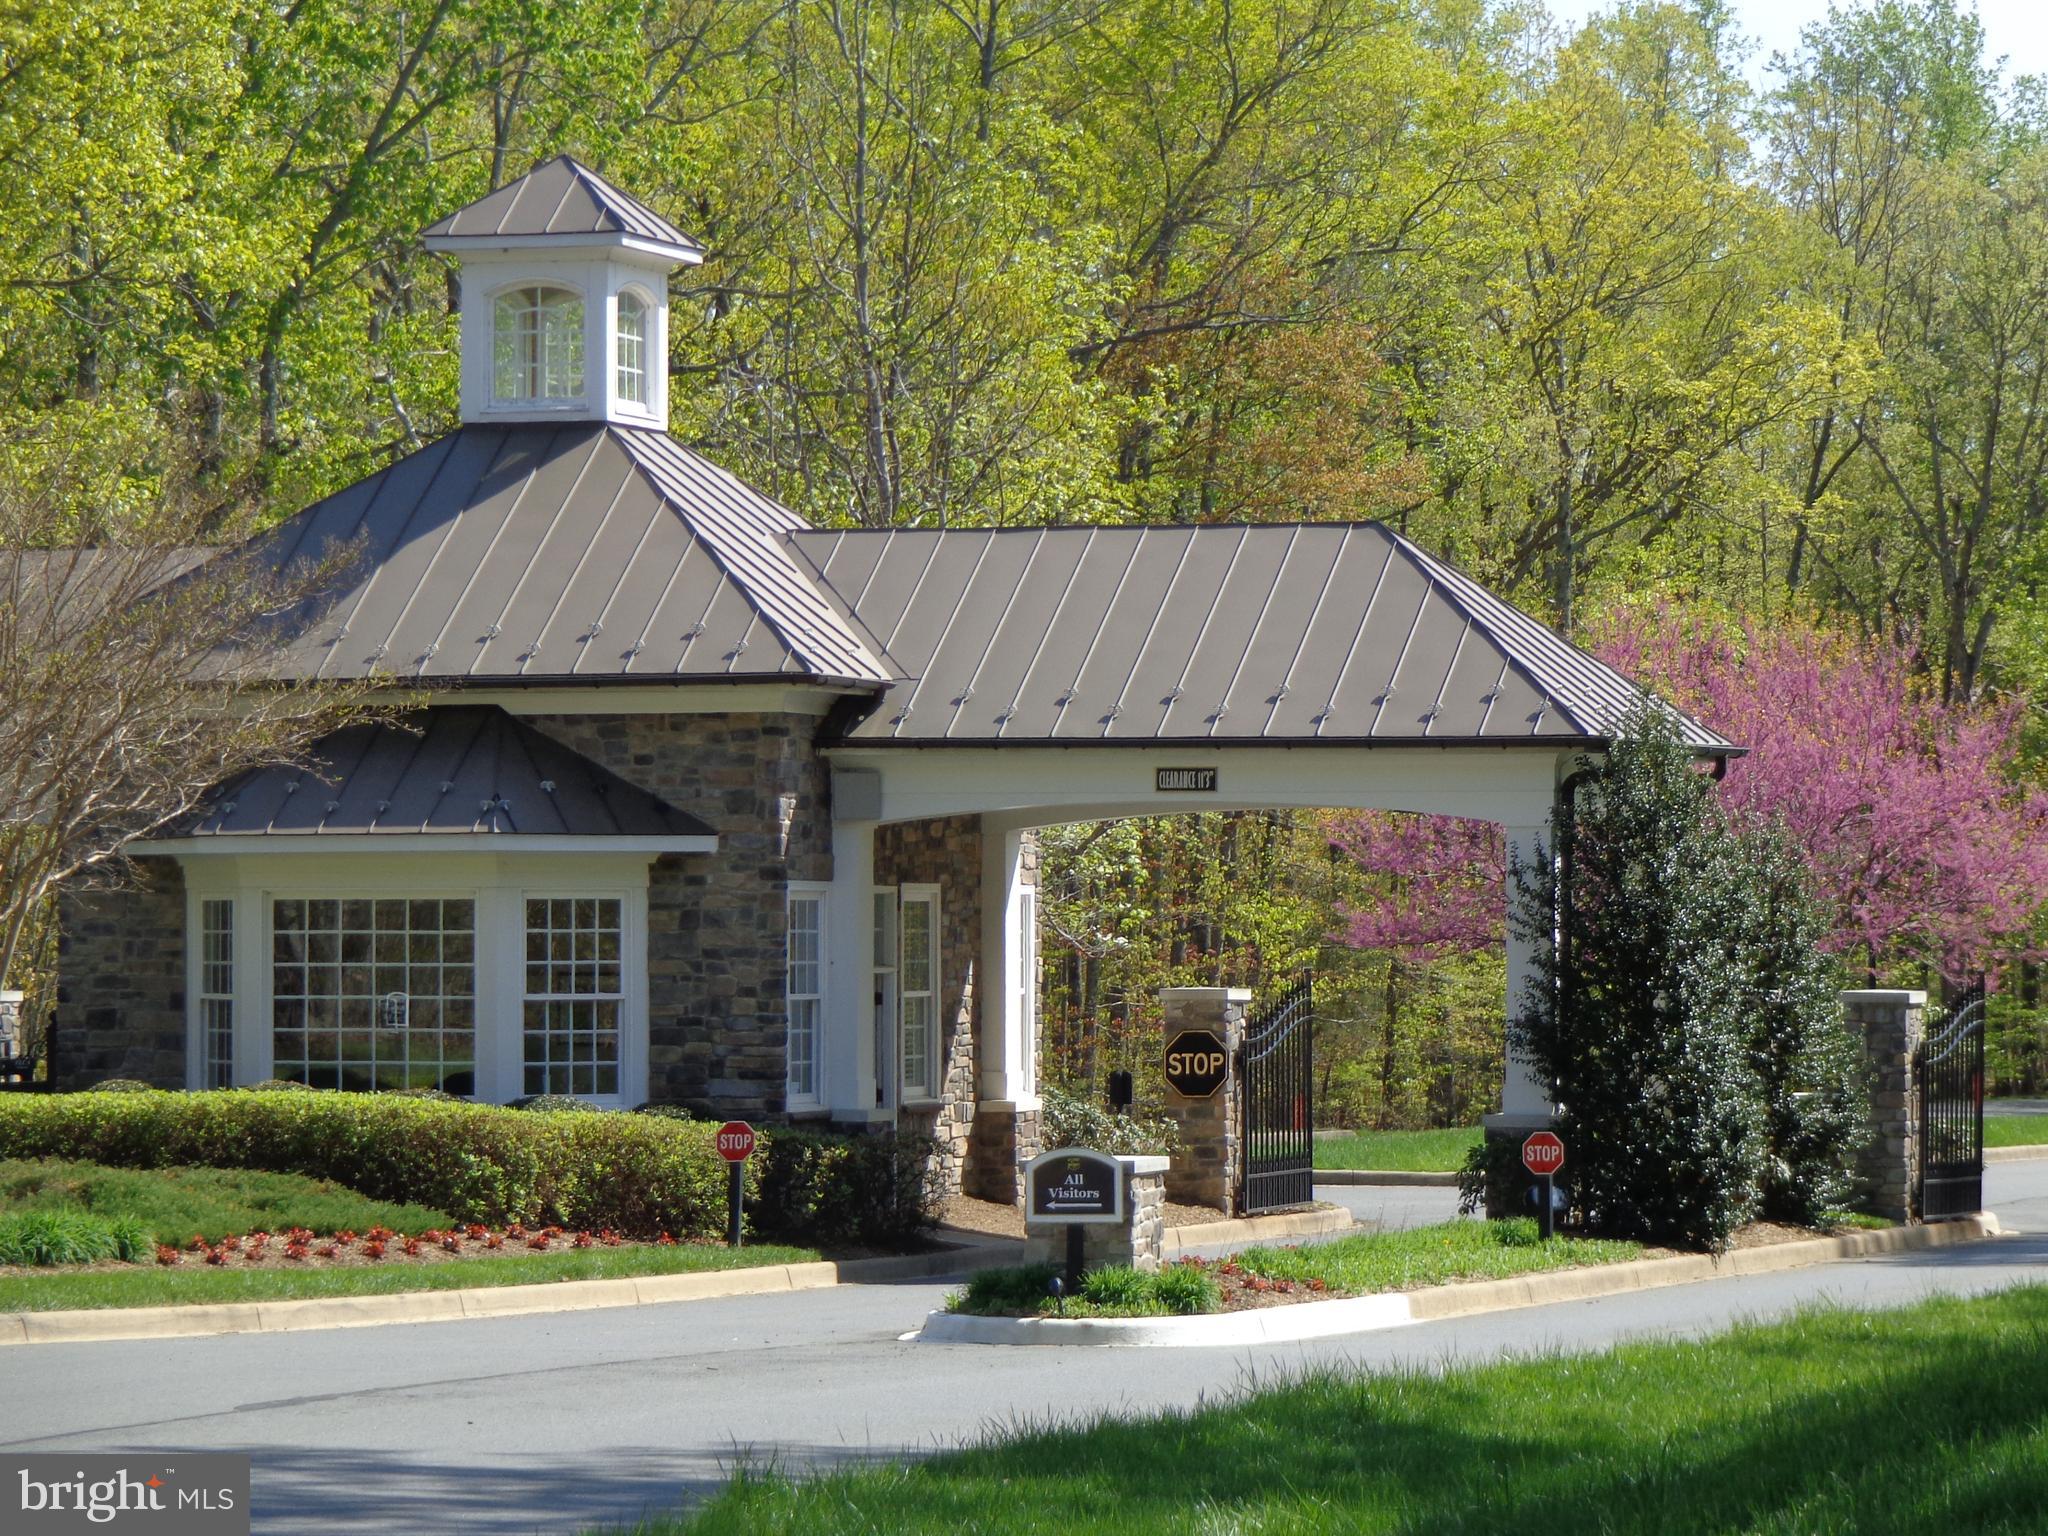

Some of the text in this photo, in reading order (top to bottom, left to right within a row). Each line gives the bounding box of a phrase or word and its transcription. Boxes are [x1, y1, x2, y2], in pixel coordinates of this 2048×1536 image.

[1159, 770, 1196, 788] CLEARANCE
[1168, 1052, 1224, 1075] STOP
[720, 1133, 752, 1149] STOP
[1527, 1145, 1560, 1161] STOP
[1064, 1174, 1084, 1185] All
[1048, 1187, 1100, 1198] Visitors
